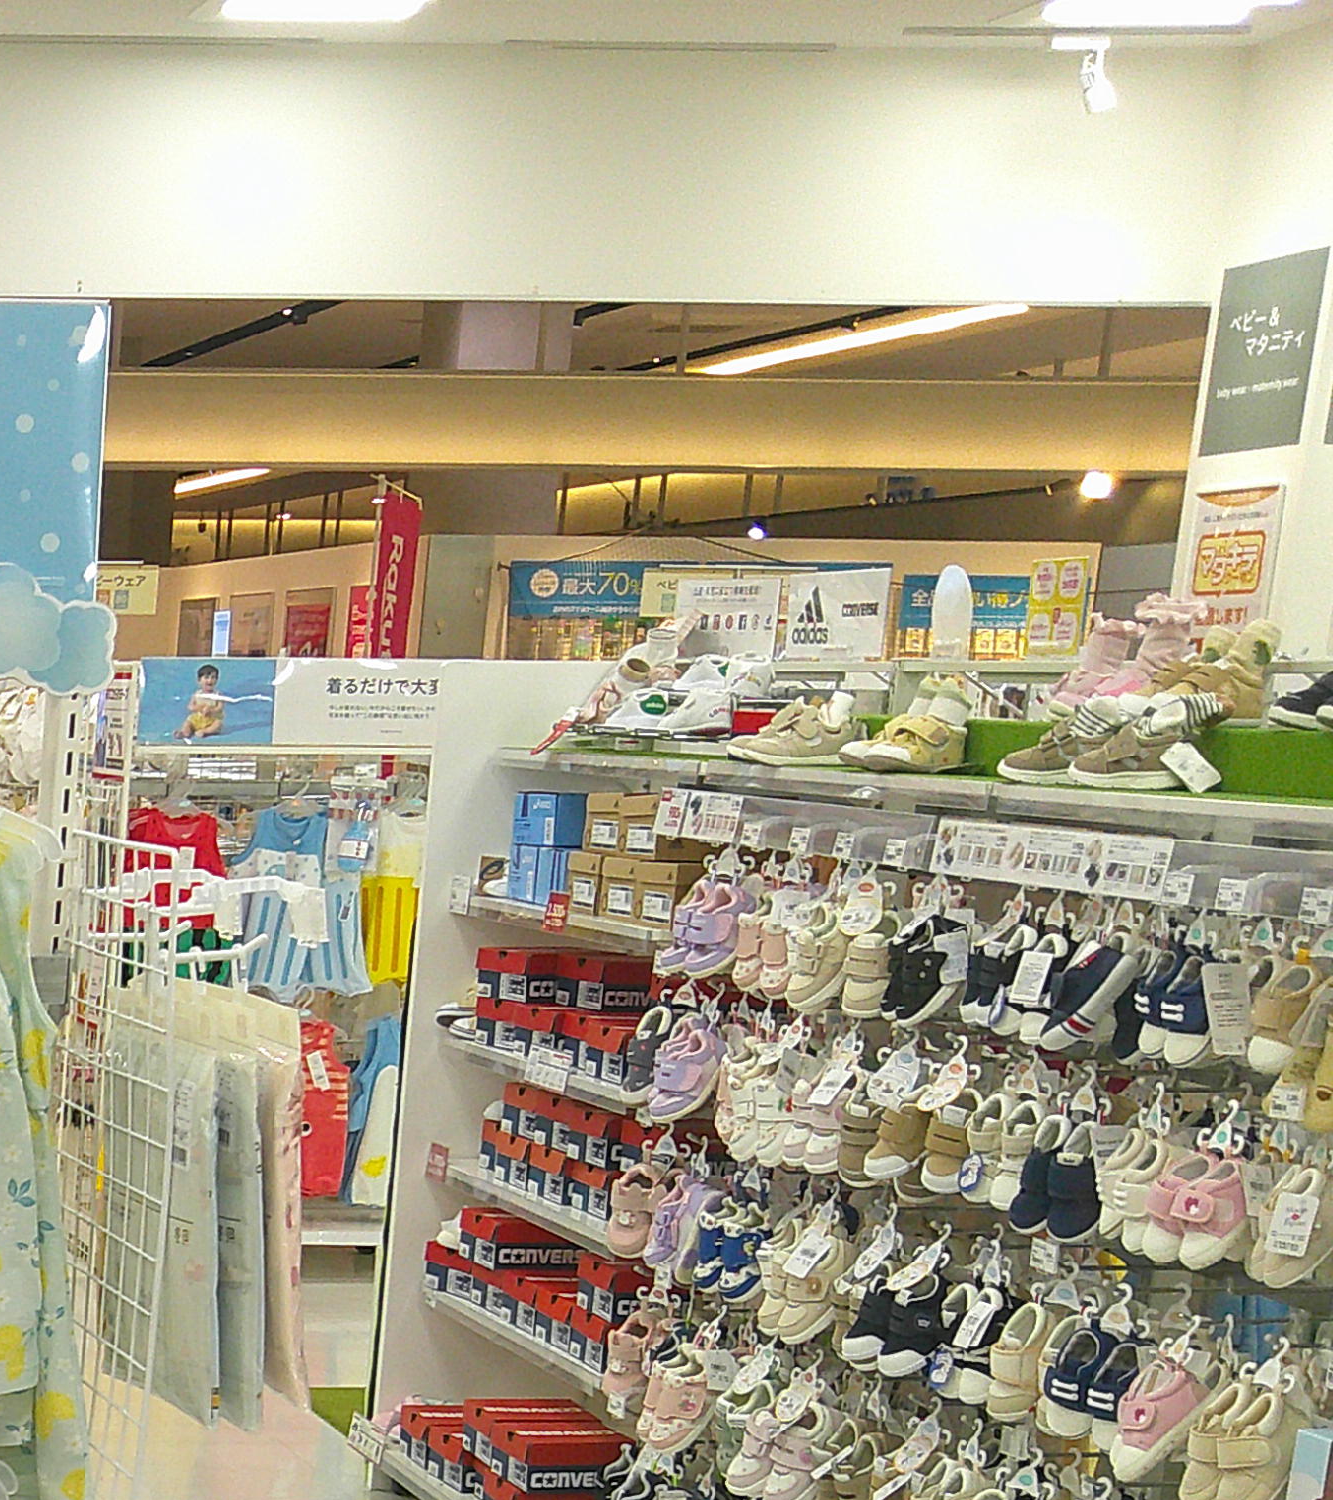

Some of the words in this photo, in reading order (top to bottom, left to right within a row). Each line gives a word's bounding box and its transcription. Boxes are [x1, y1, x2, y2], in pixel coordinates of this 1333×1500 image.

[1229, 306, 1279, 332] ベビー&
[1245, 330, 1305, 356] マタニティ
[791, 628, 829, 645] adidas
